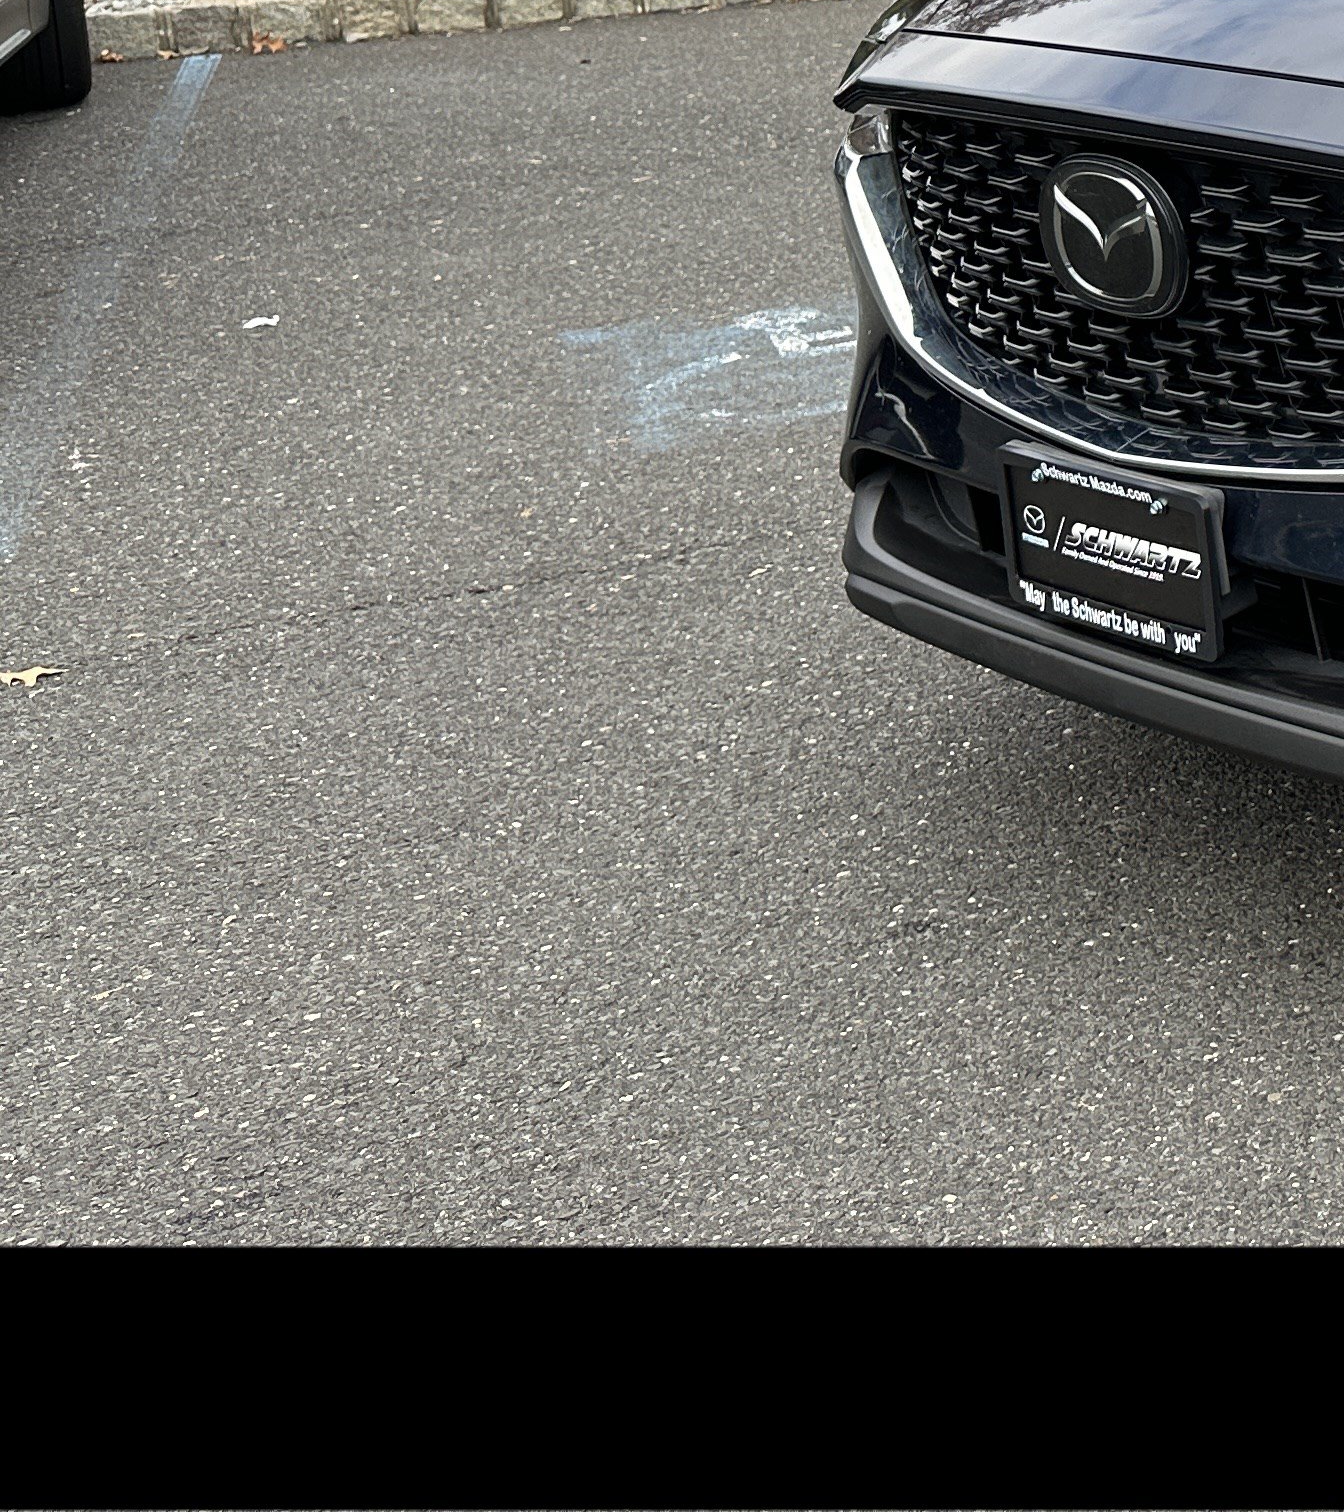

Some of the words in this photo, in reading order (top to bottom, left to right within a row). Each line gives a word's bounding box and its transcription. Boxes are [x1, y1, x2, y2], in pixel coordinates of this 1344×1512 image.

[1064, 522, 1202, 580] SCHWARTZ
[1051, 591, 1070, 616] the
[1071, 597, 1123, 632] Schwartz
[1123, 612, 1139, 637] be
[1140, 620, 1166, 645] with
